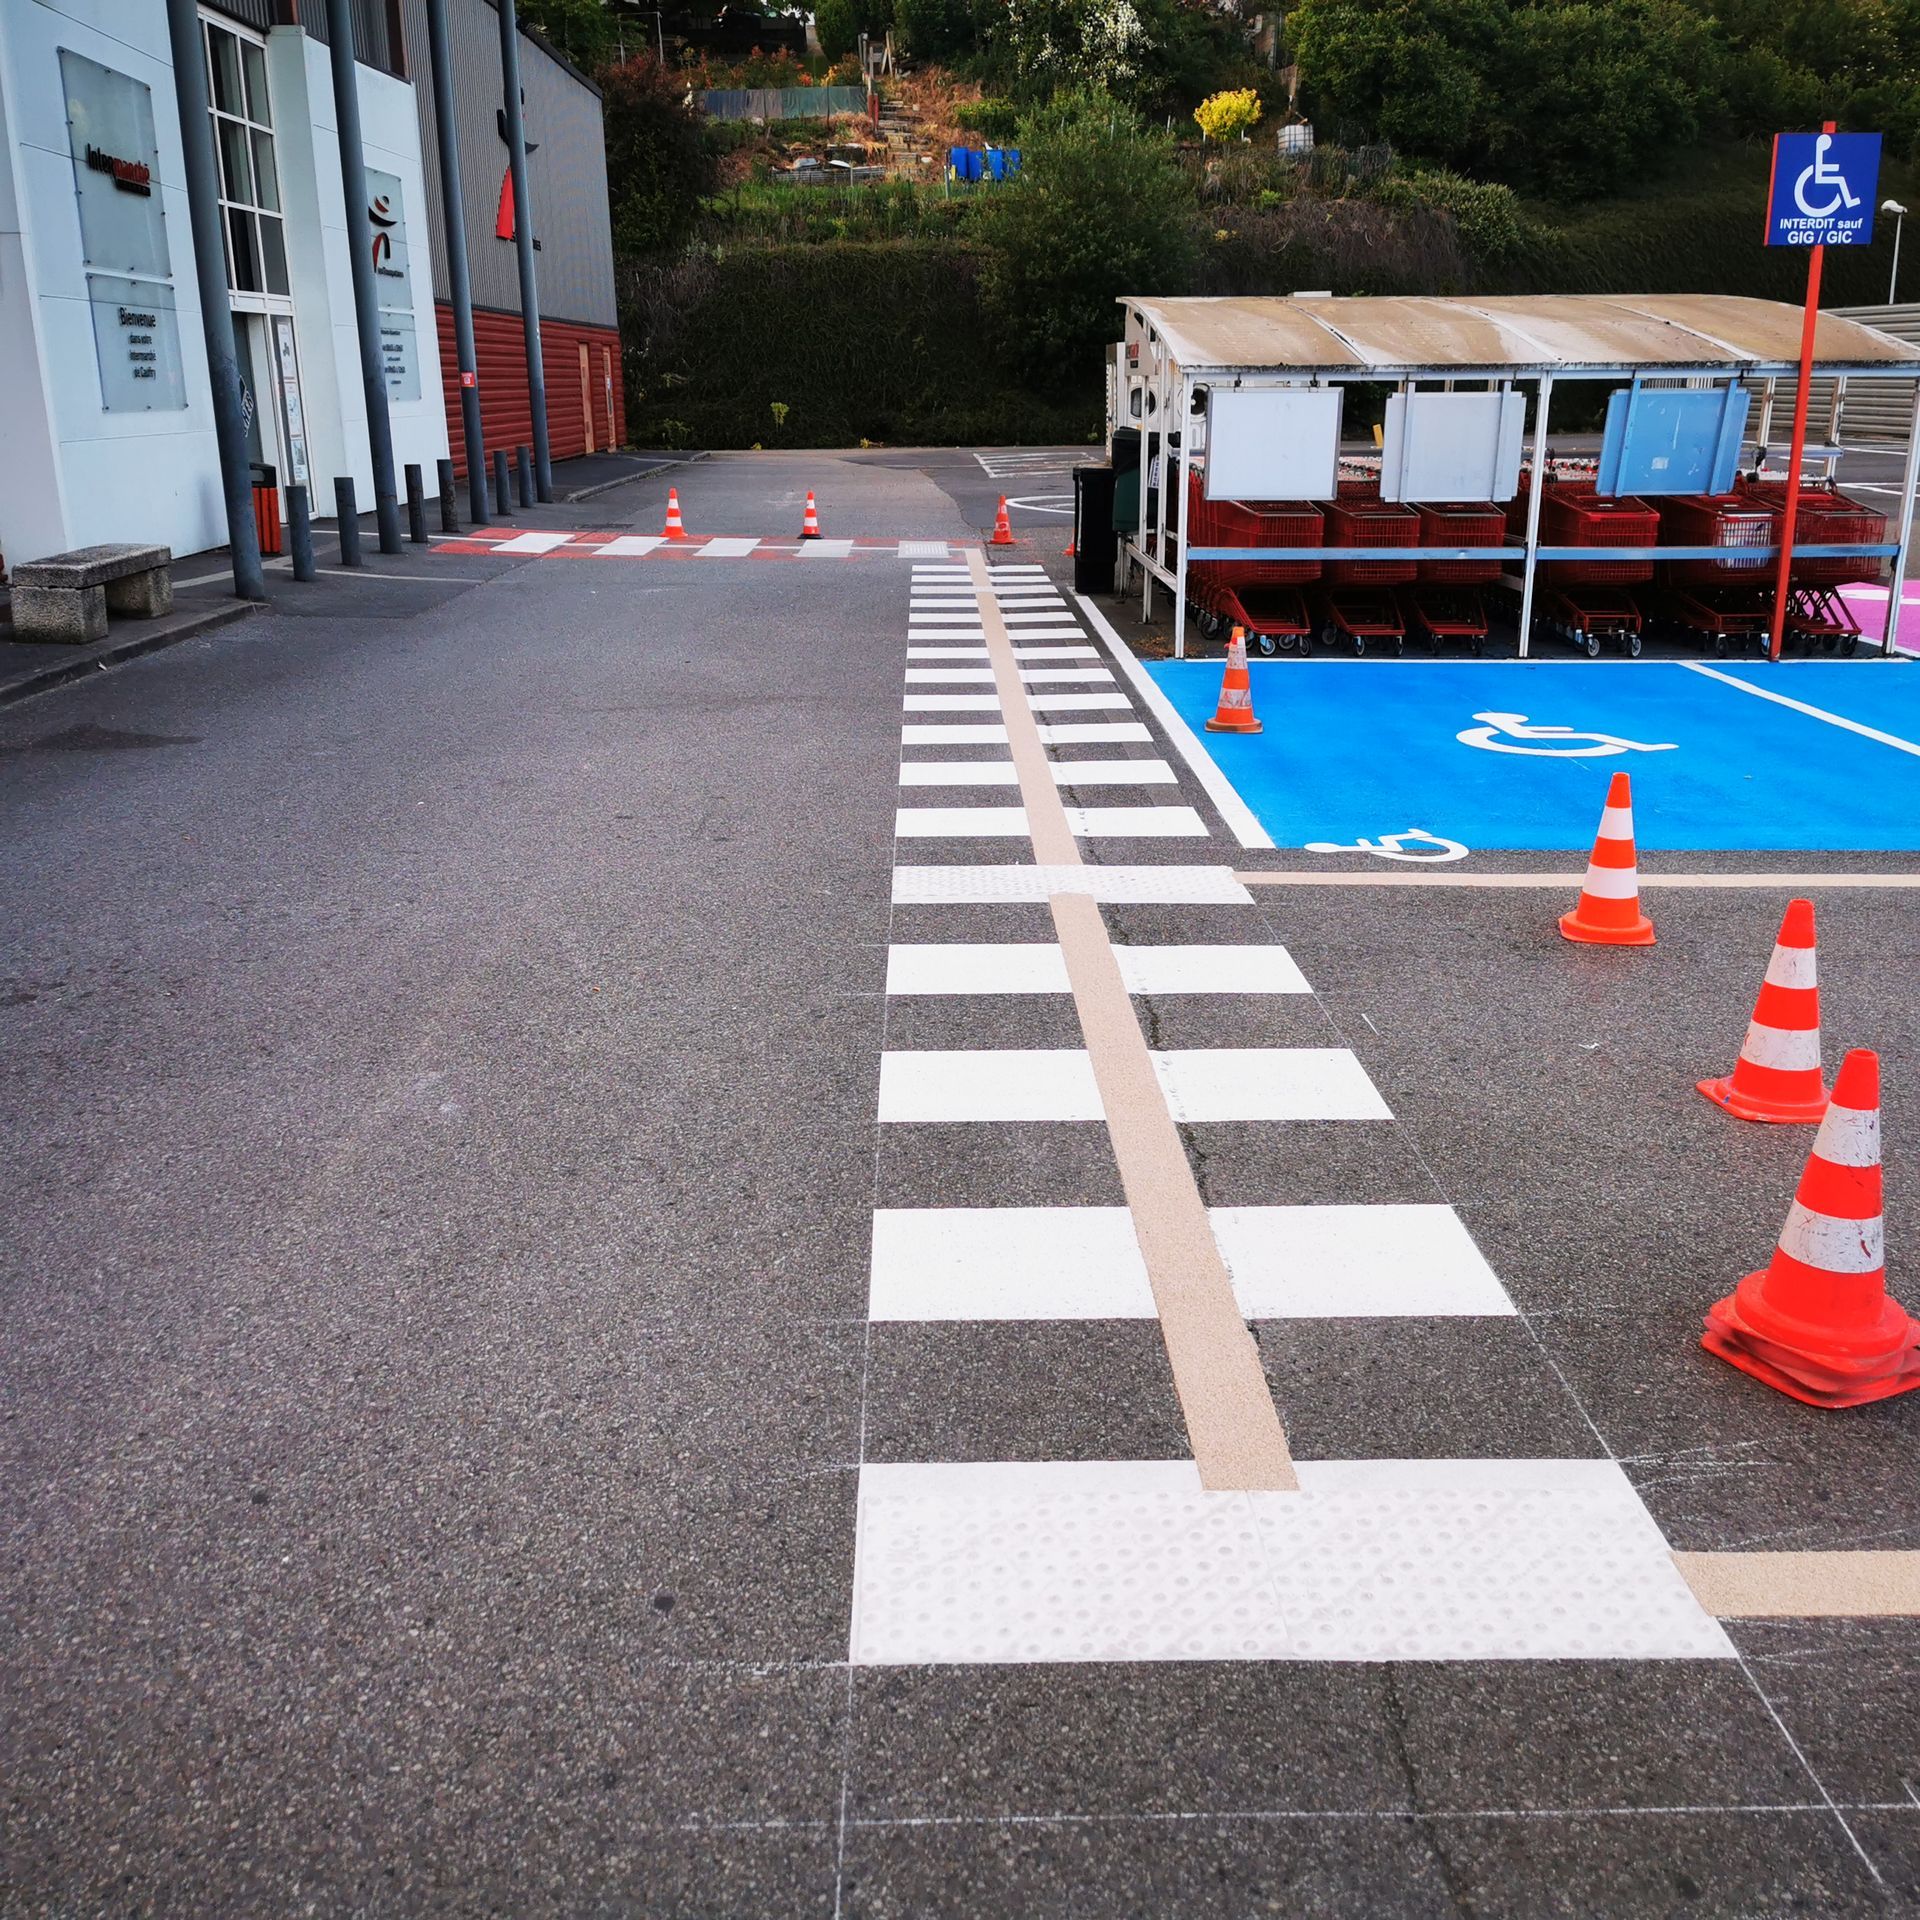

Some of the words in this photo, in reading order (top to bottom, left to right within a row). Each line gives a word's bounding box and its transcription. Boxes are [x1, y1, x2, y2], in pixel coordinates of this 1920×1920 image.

[1779, 218, 1835, 229] INTERDIT
[1837, 218, 1863, 229] sauf
[1787, 231, 1815, 244] GIG
[1817, 231, 1824, 244] /
[1826, 231, 1853, 244] GIC
[118, 307, 156, 328] Bienvenue
